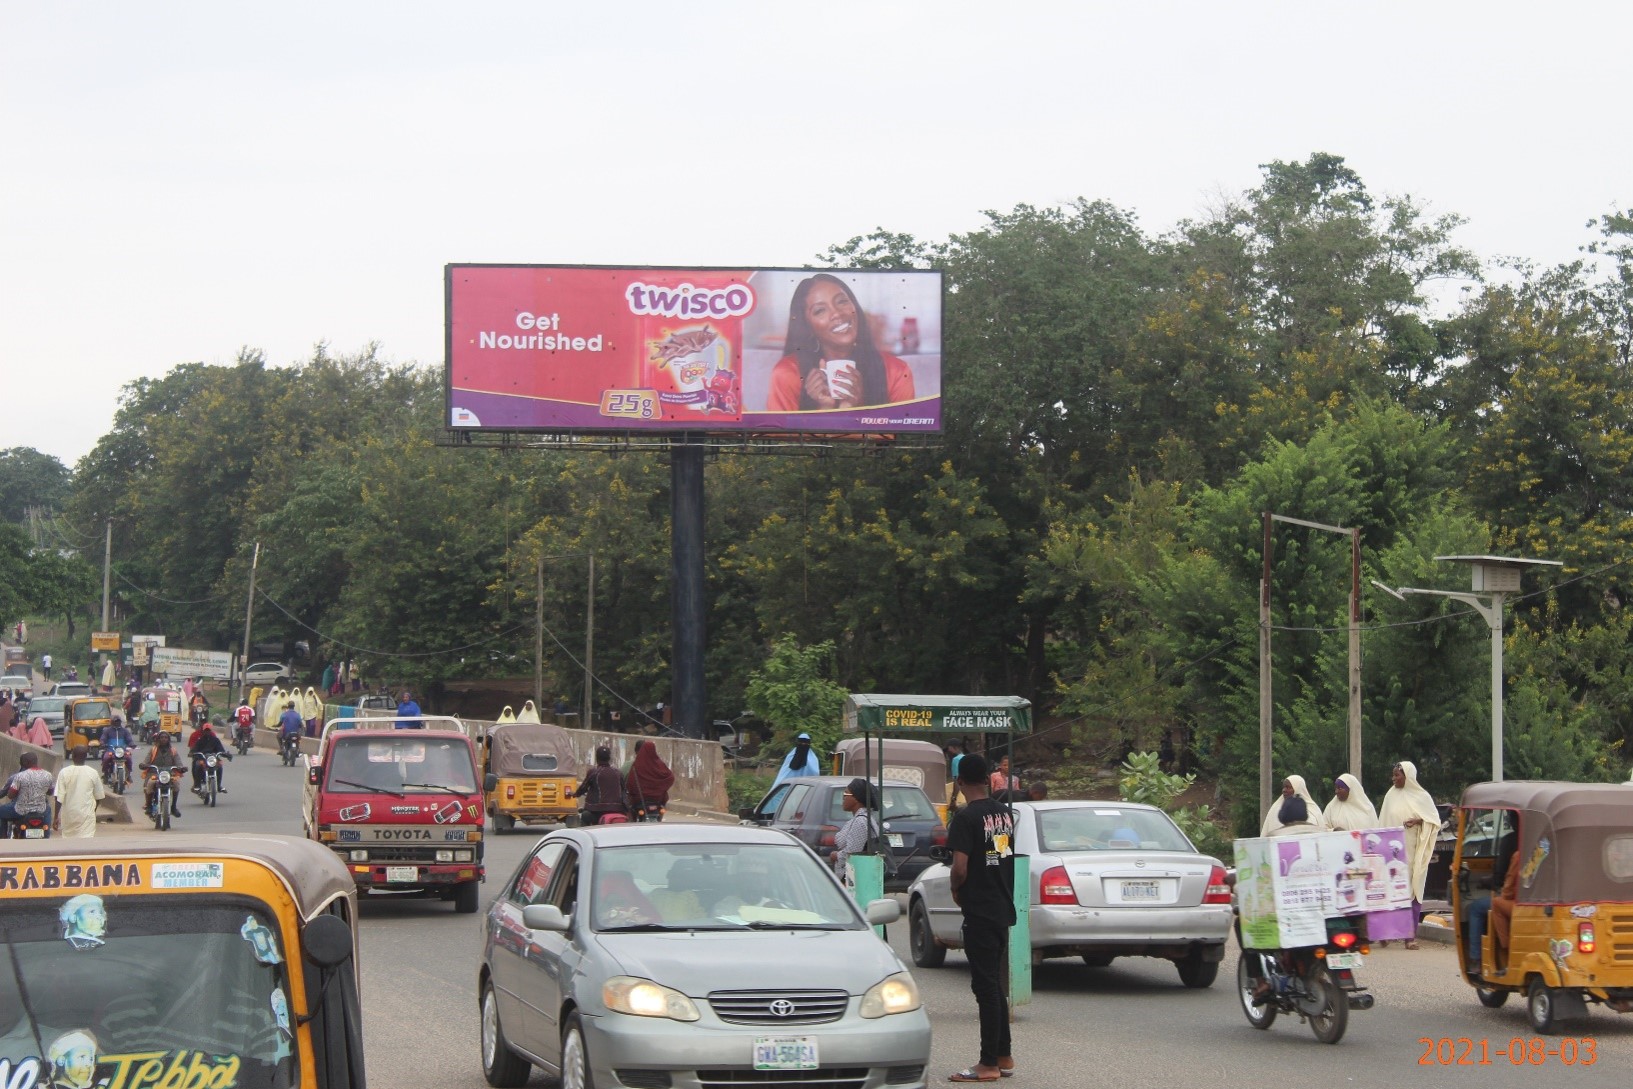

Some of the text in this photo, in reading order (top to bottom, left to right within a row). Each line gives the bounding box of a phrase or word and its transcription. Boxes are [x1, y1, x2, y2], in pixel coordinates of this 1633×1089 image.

[629, 285, 750, 317] twisco
[516, 311, 560, 332] Get
[479, 332, 602, 352] Nourished
[608, 393, 654, 418] 25g
[885, 709, 932, 719] COVID-19
[886, 718, 932, 727] IS REAL
[942, 717, 1012, 728] FACE MASK
[374, 829, 432, 840] TOYOTA
[0, 863, 142, 890] RABBANA
[155, 870, 218, 879] ACOMORAN
[163, 878, 208, 887] MEMBER
